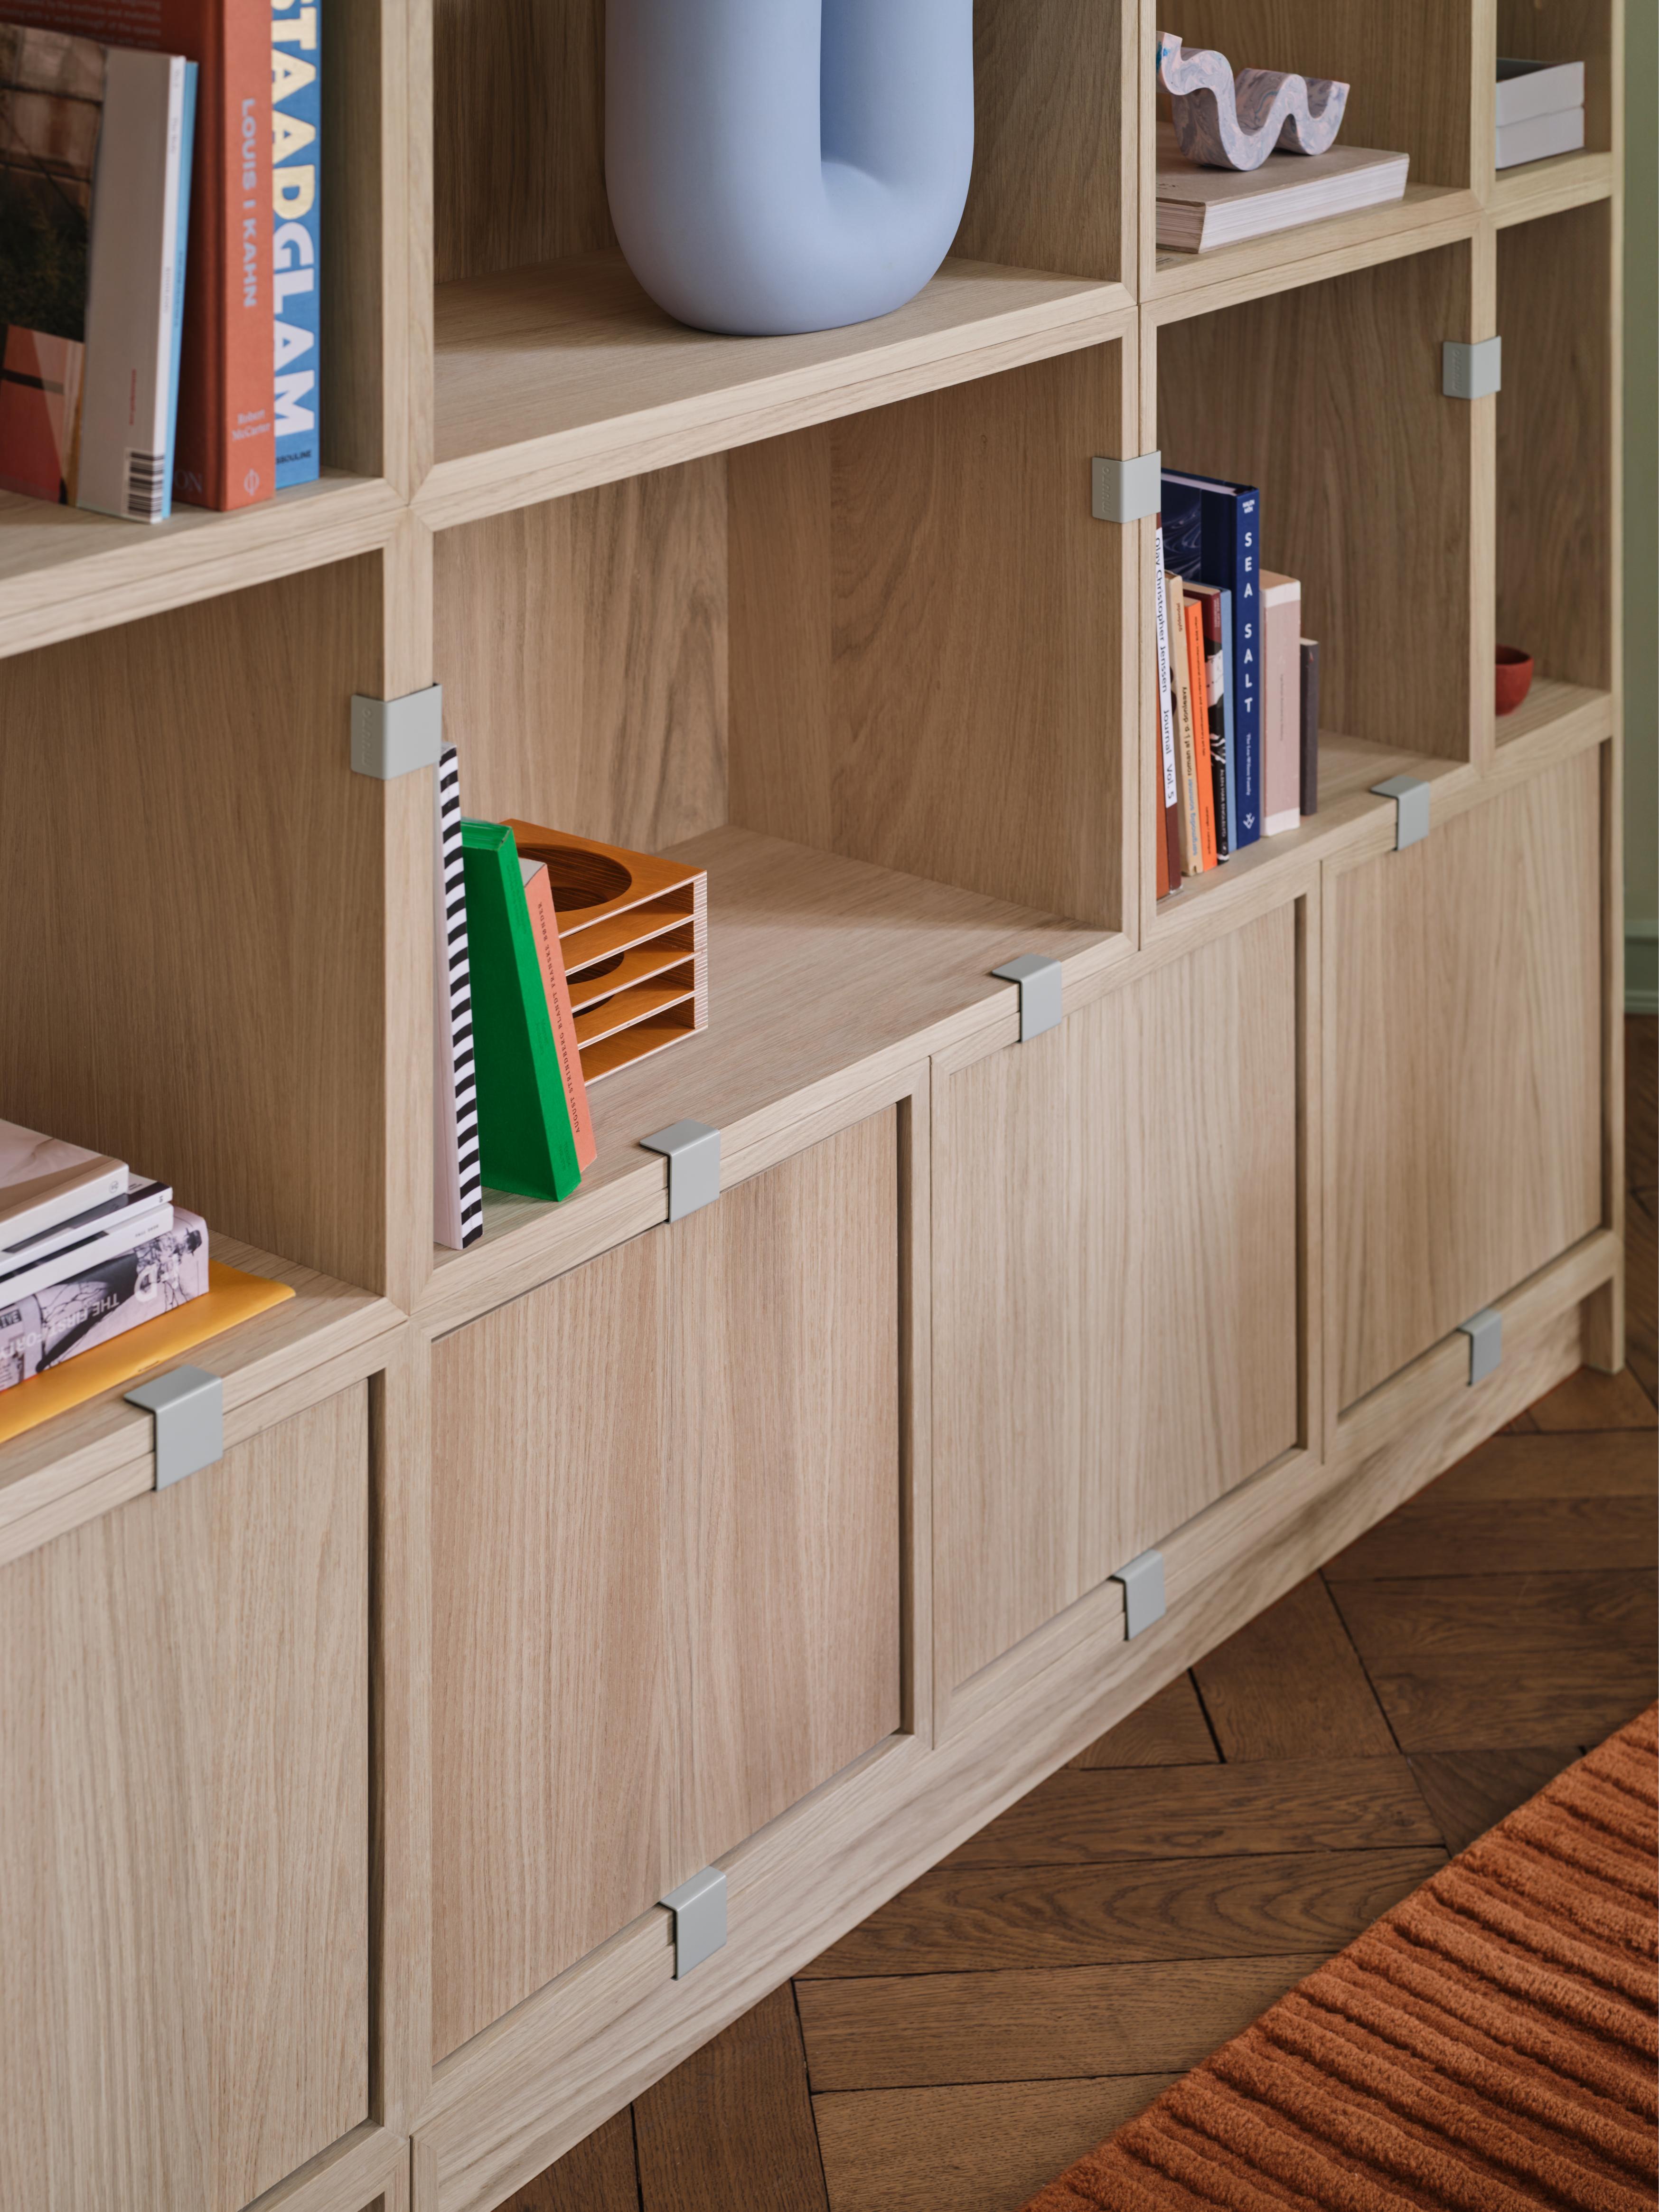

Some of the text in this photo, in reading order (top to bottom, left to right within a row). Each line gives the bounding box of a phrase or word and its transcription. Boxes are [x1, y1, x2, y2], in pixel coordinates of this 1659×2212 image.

[271, 0, 317, 220] TAAD
[241, 98, 256, 191] LOUIS
[243, 218, 257, 307] KAHN
[232, 422, 271, 442] McCarter
[237, 409, 266, 425] Robert
[1156, 570, 1165, 642] Christopher
[1244, 532, 1253, 713] SEA SALT
[1160, 646, 1168, 692] Jenssen
[1163, 709, 1172, 754] Journal
[1166, 764, 1174, 788] Vol.
[1168, 791, 1174, 800] 5
[538, 902, 581, 1134] AUGUST STRINDBERG BLANDT FRANSKE BØNDER
[49, 1307, 89, 1337] FIRST
[93, 1293, 120, 1317] THE
